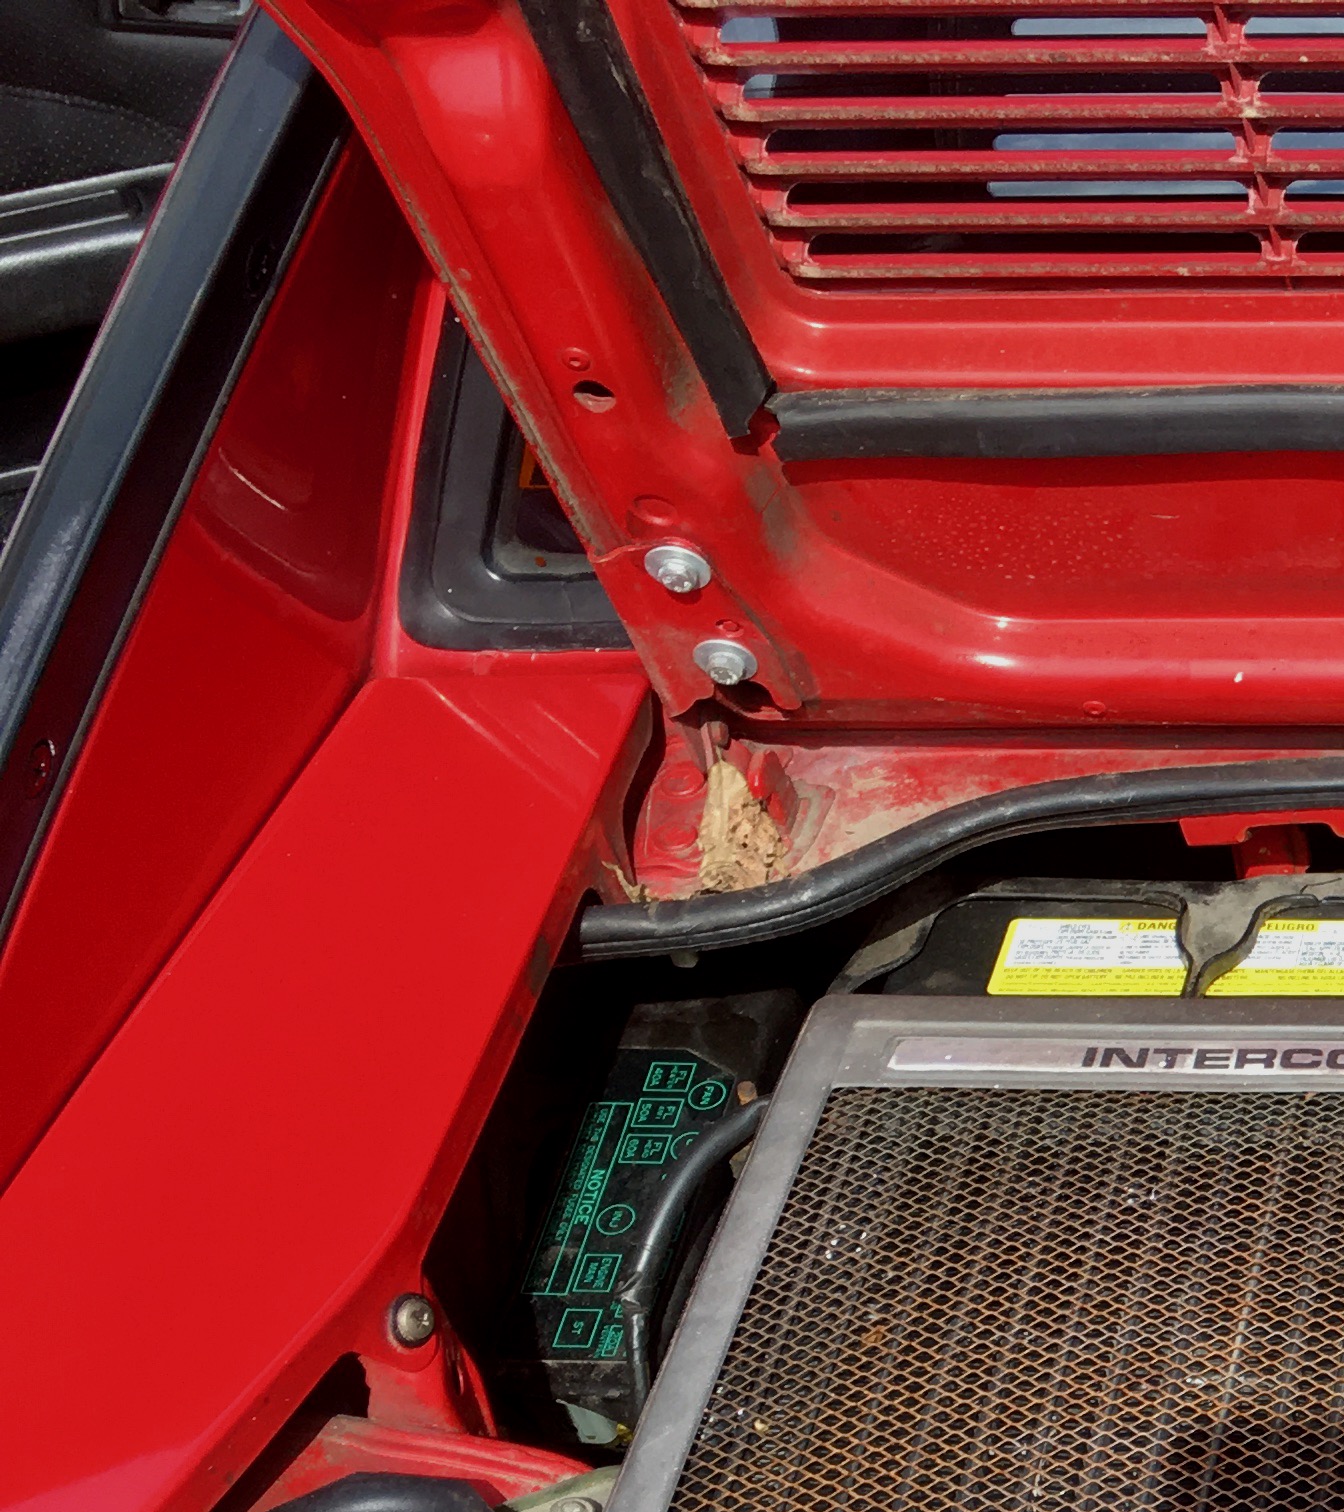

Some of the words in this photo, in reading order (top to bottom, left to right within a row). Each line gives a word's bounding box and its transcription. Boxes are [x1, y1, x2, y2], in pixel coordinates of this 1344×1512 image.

[1137, 922, 1177, 931] DANG
[674, 1070, 688, 1084] FL
[699, 1085, 715, 1105] FAN
[637, 1103, 653, 1122] 50A
[662, 1104, 676, 1120] FL
[624, 1138, 640, 1159] 60A
[649, 1142, 664, 1157] FL
[573, 1168, 606, 1226] NOTICE
[608, 1210, 623, 1228] INJ
[571, 1320, 584, 1336] ST
